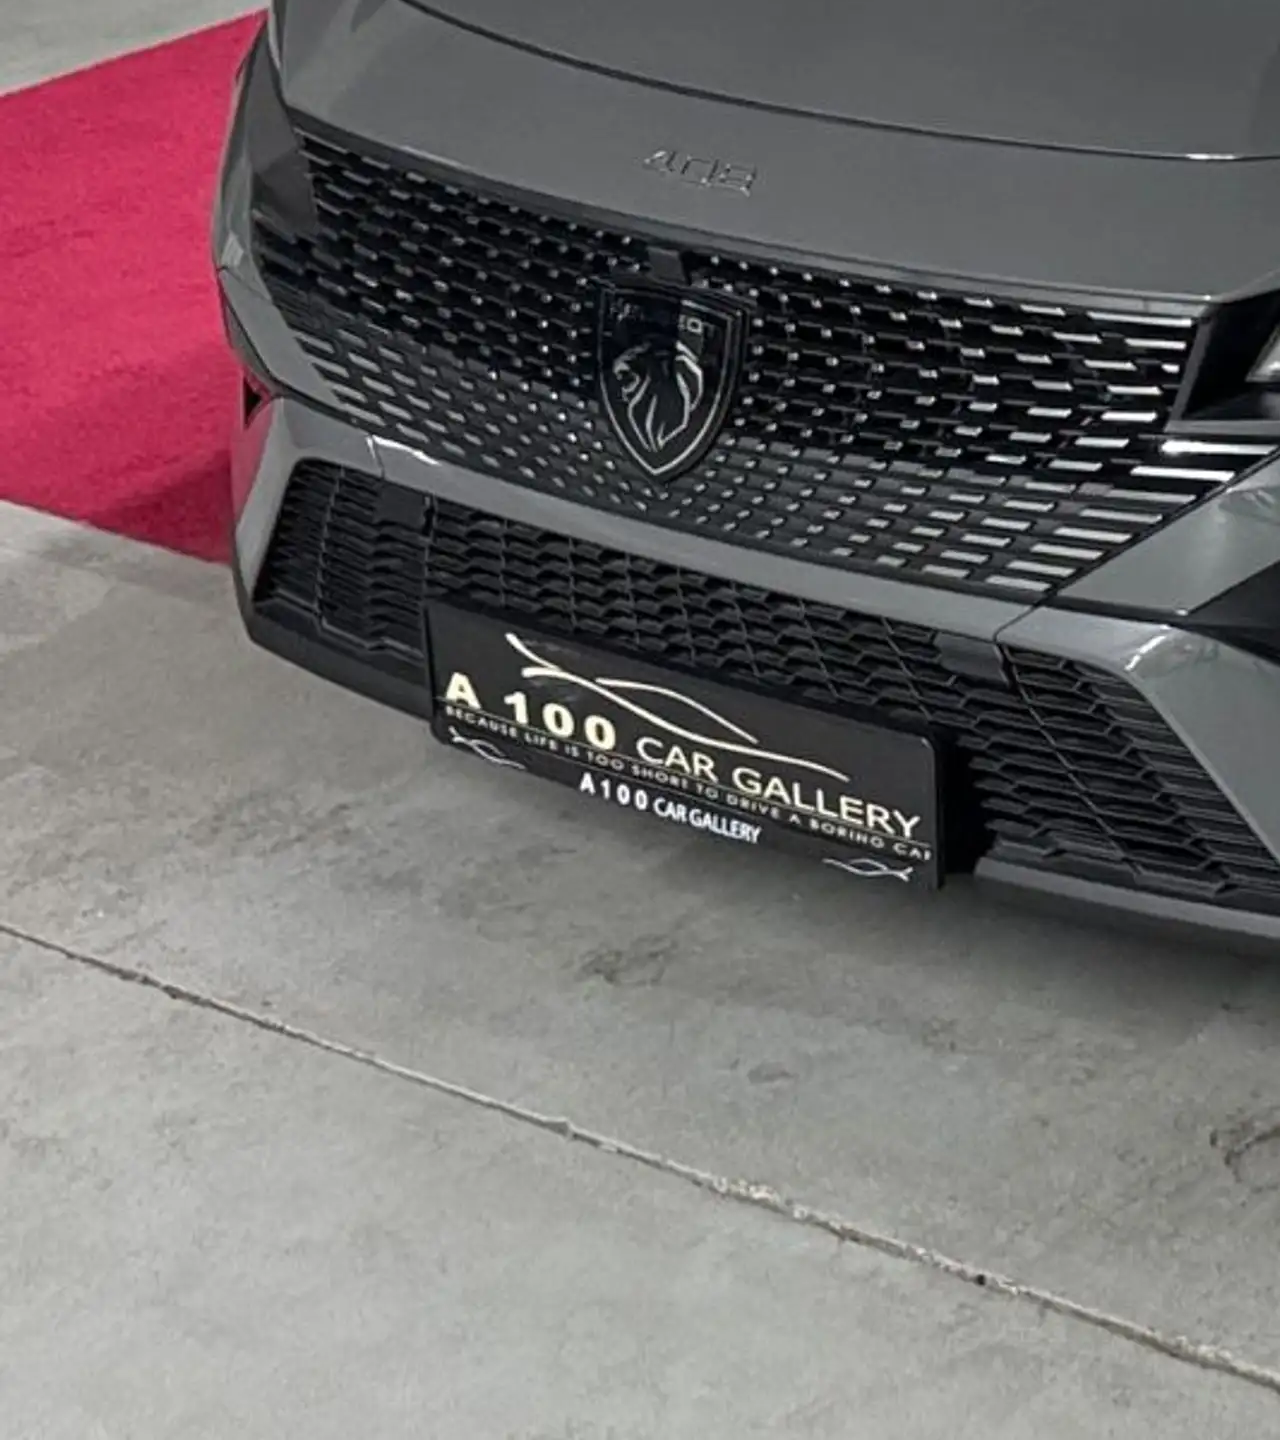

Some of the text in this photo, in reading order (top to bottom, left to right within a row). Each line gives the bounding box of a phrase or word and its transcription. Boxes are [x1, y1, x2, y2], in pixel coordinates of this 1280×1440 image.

[643, 150, 758, 197] 408
[445, 671, 481, 710] A
[636, 736, 719, 784] CAR
[732, 766, 920, 838] GALLERY
[445, 705, 519, 738] BECAUSE
[524, 732, 558, 750] LIFE
[565, 744, 580, 757] IS
[587, 750, 626, 771] TOO
[631, 762, 689, 790] SHORT
[696, 782, 721, 799] TO
[726, 793, 780, 819] DRIVE
[789, 812, 803, 826] A
[809, 818, 885, 849] BORING
